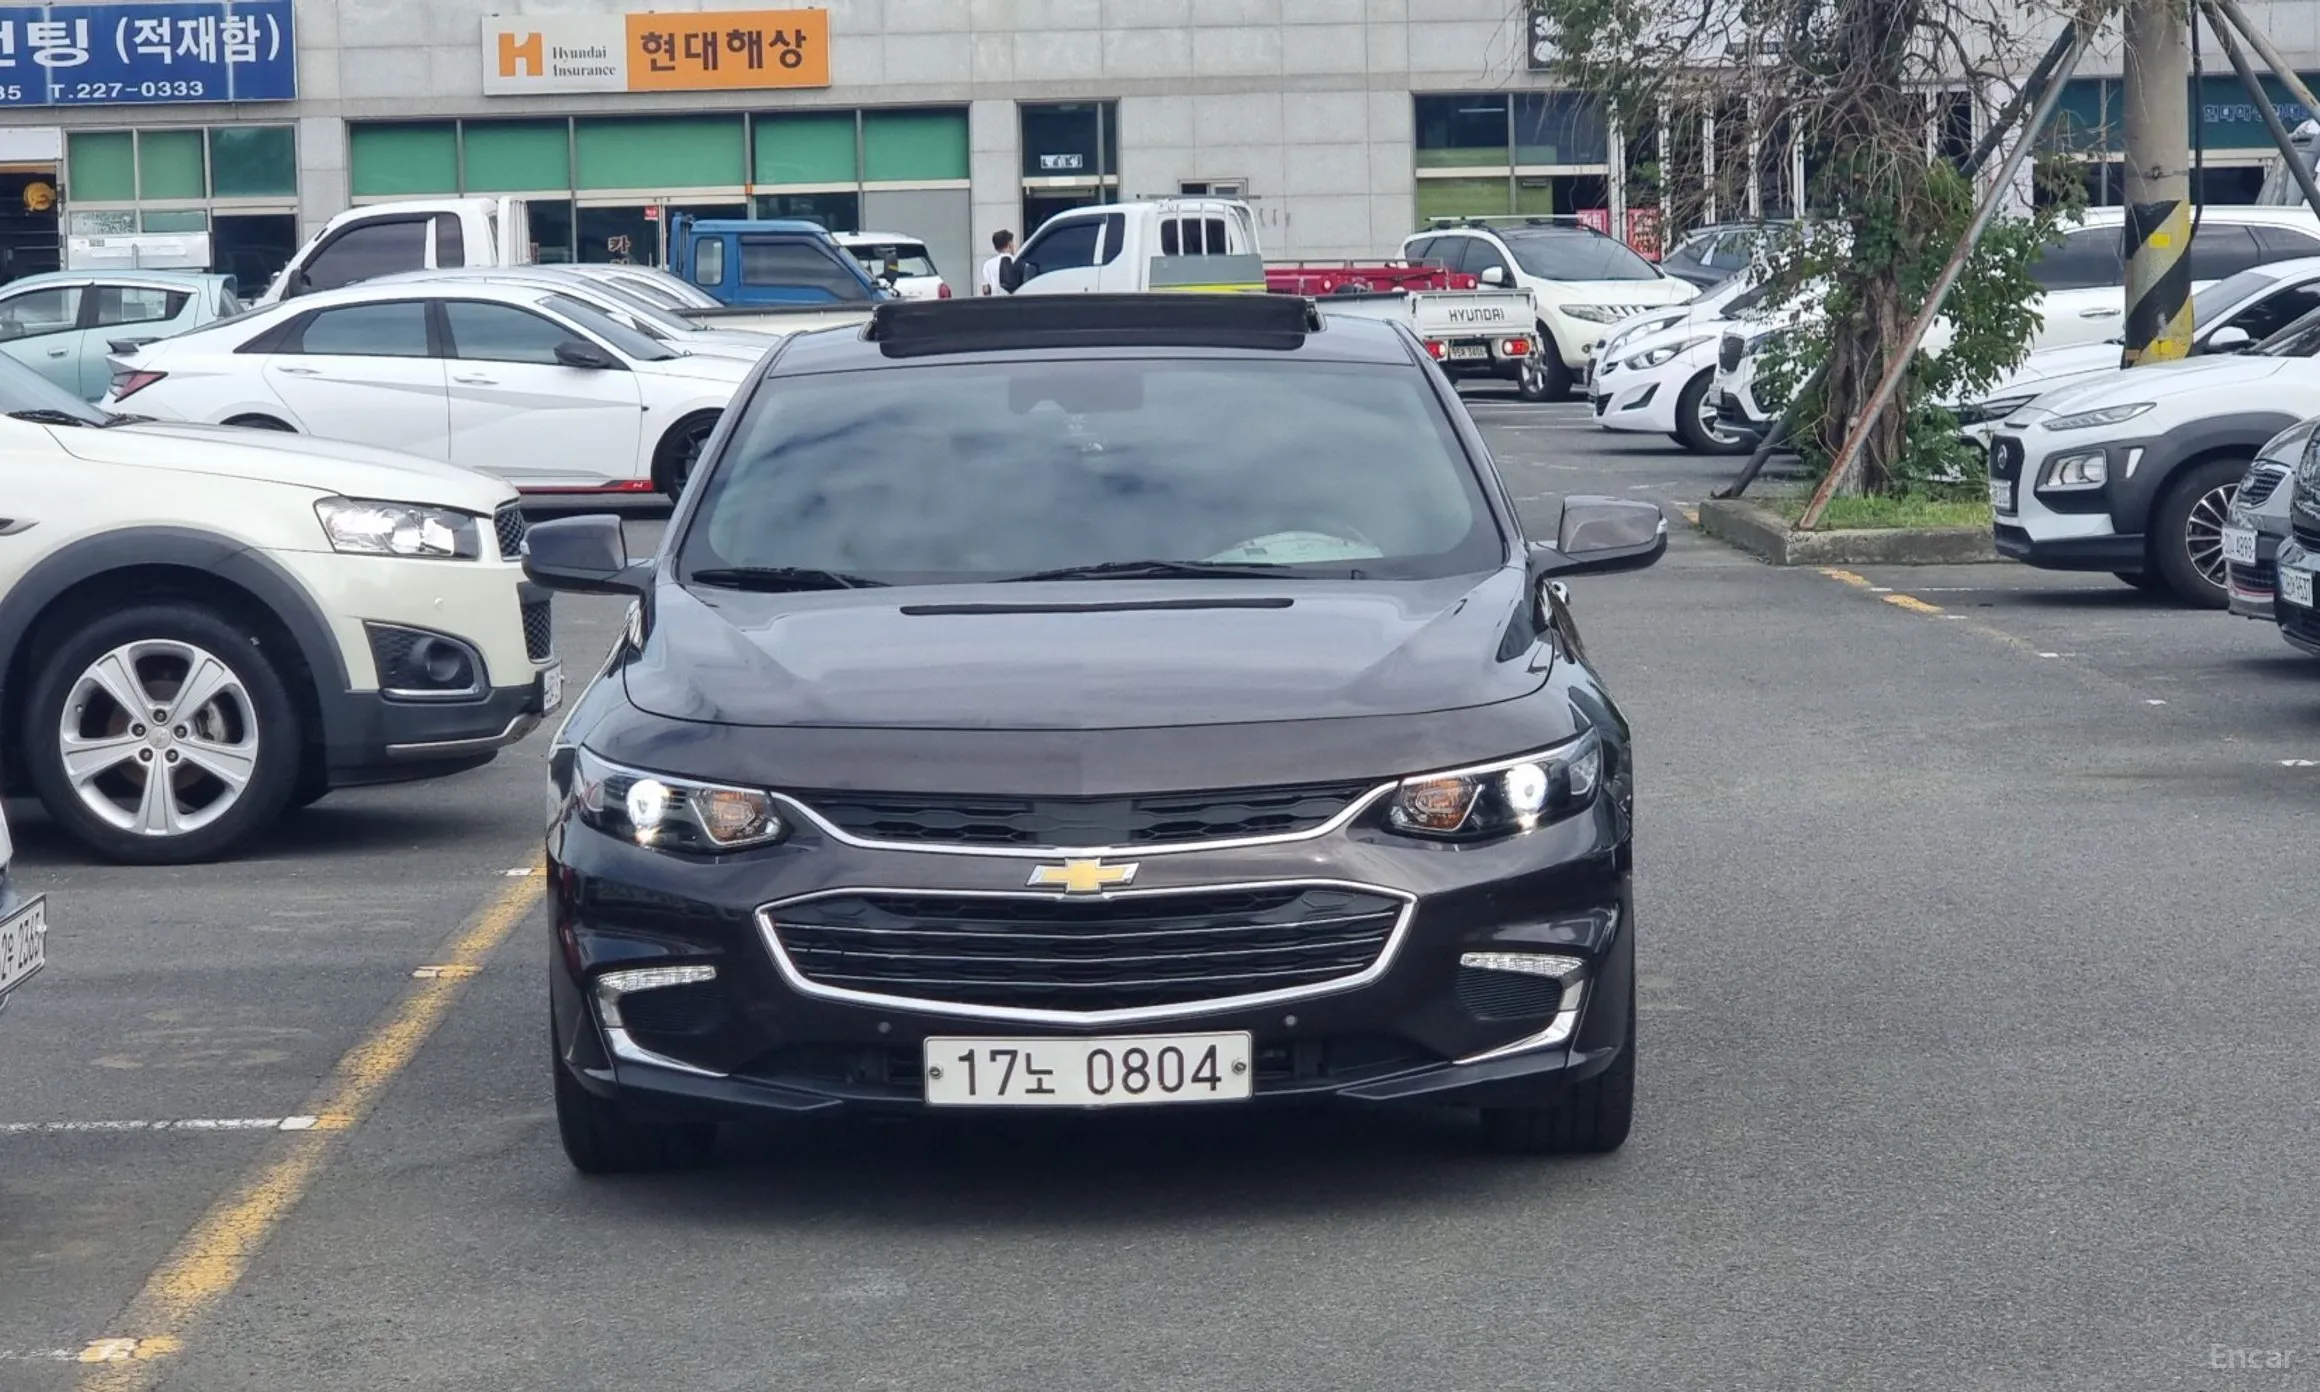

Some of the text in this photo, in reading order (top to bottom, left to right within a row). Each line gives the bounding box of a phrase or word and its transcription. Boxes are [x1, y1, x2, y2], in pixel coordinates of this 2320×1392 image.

[0, 13, 280, 67] 팅 (적재함)
[552, 45, 607, 62] Hyundai
[640, 28, 807, 72] 현대해상
[552, 64, 616, 77] Insurance
[48, 81, 204, 99] T.227-0333
[1448, 308, 1505, 322] HYUNDAI
[958, 1044, 1222, 1096] 17노 0804
